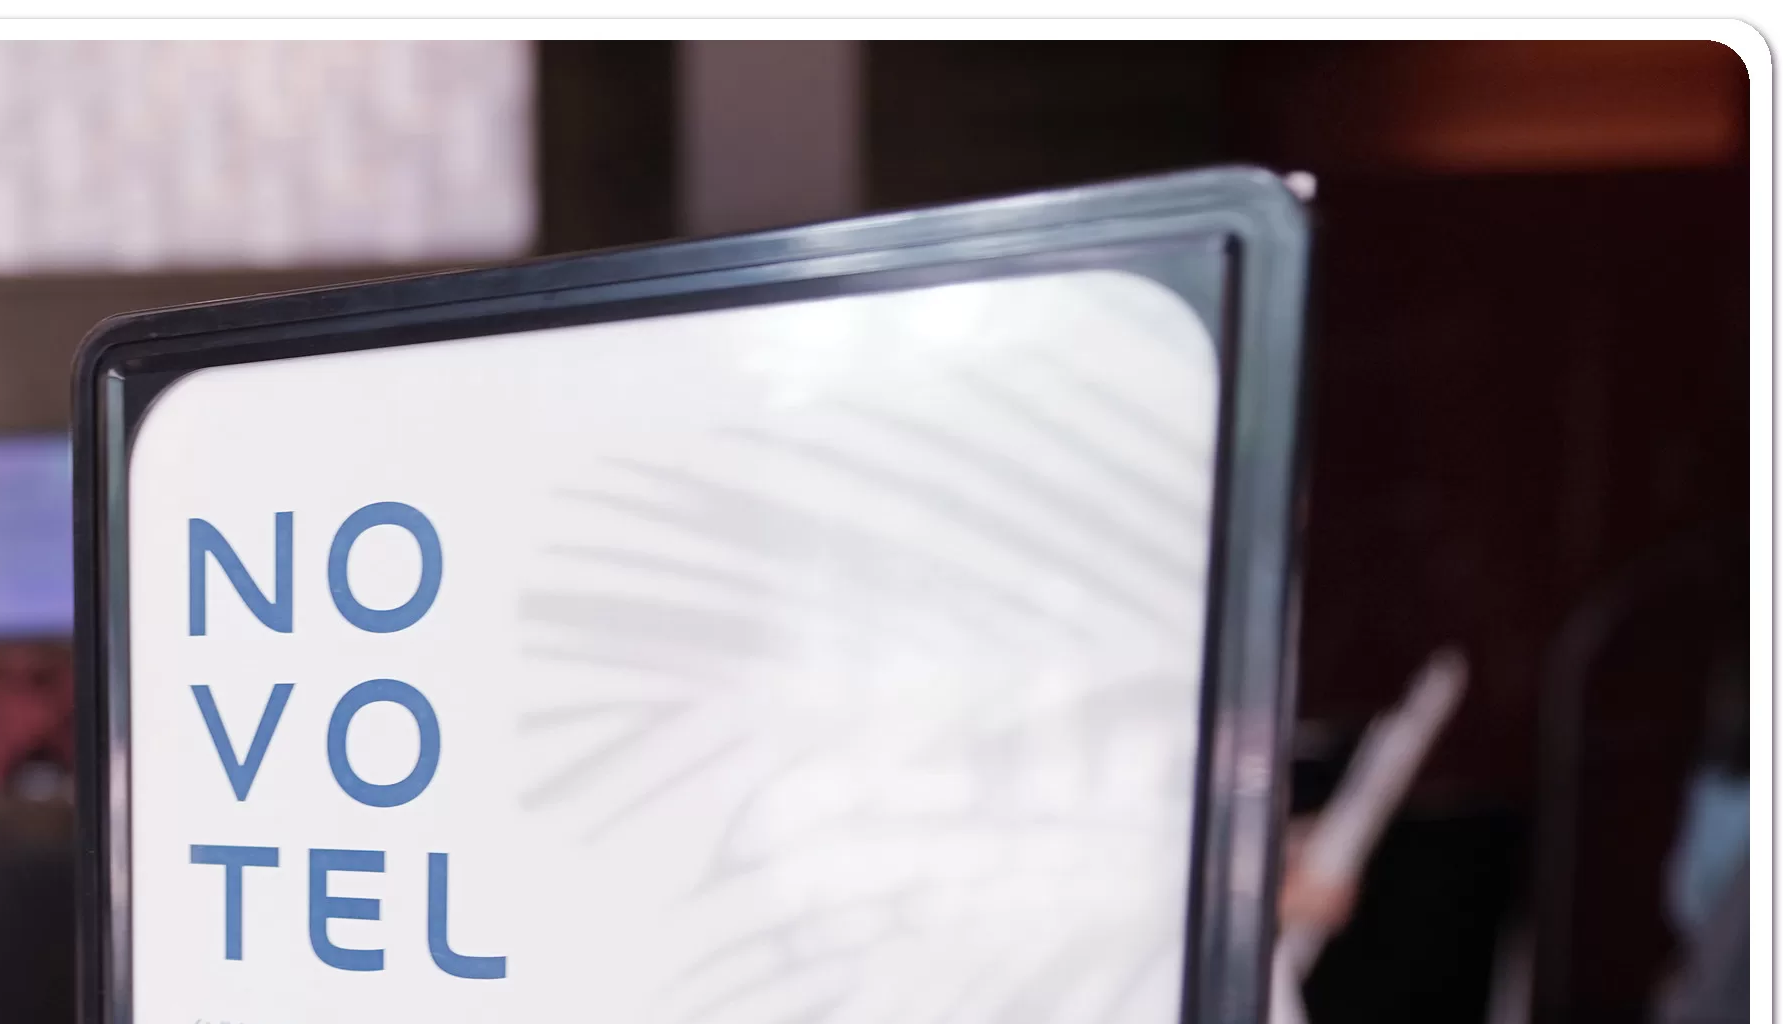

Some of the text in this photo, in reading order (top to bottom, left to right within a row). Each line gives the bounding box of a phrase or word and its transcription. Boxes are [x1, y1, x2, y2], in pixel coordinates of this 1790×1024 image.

[188, 501, 443, 637] NO
[189, 678, 442, 808] VO
[189, 844, 507, 980] TEL
